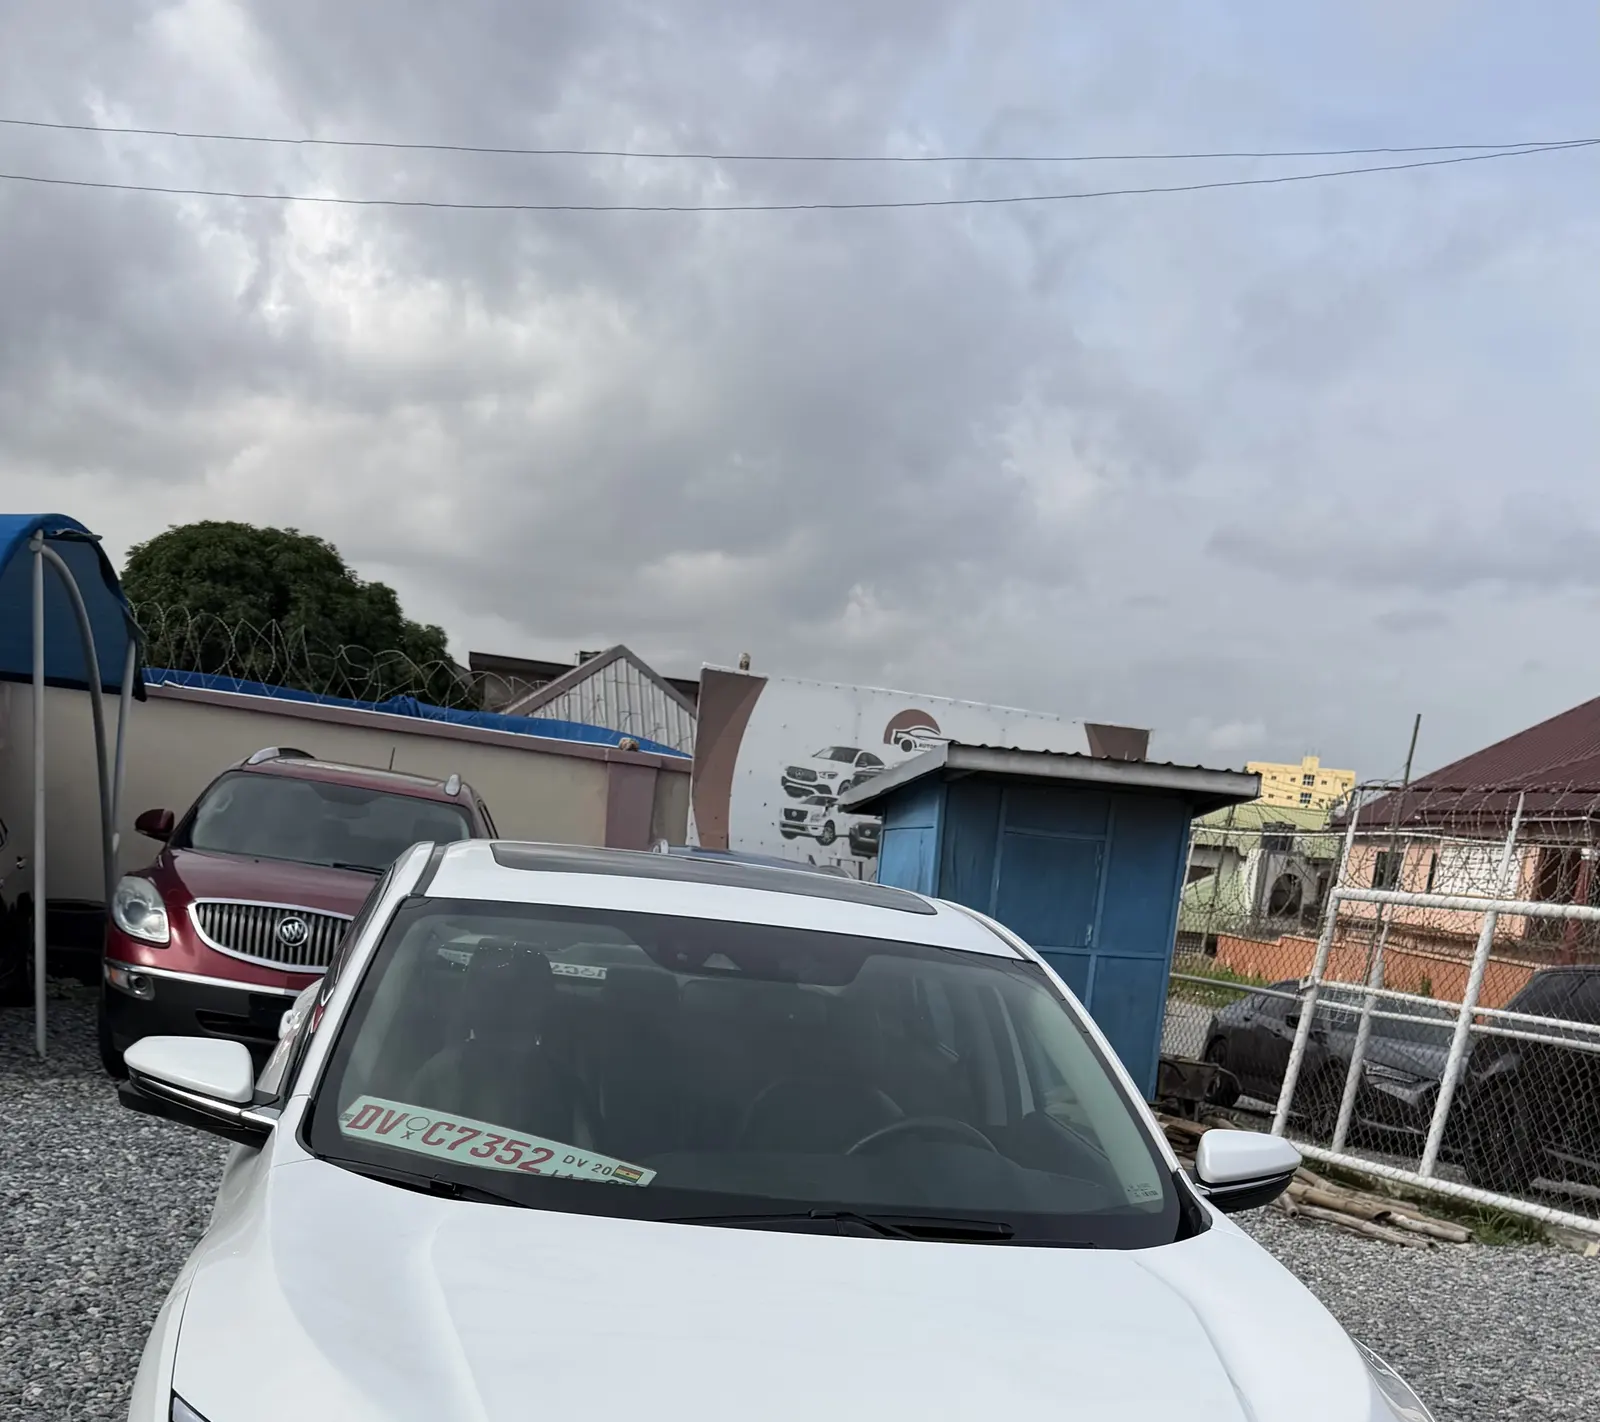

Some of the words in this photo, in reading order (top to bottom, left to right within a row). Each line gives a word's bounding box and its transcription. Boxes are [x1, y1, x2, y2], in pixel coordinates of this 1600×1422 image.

[345, 1104, 410, 1135] DV
[421, 1121, 555, 1174] C7352
[562, 1154, 588, 1168] DV
[591, 1163, 613, 1176] 20
